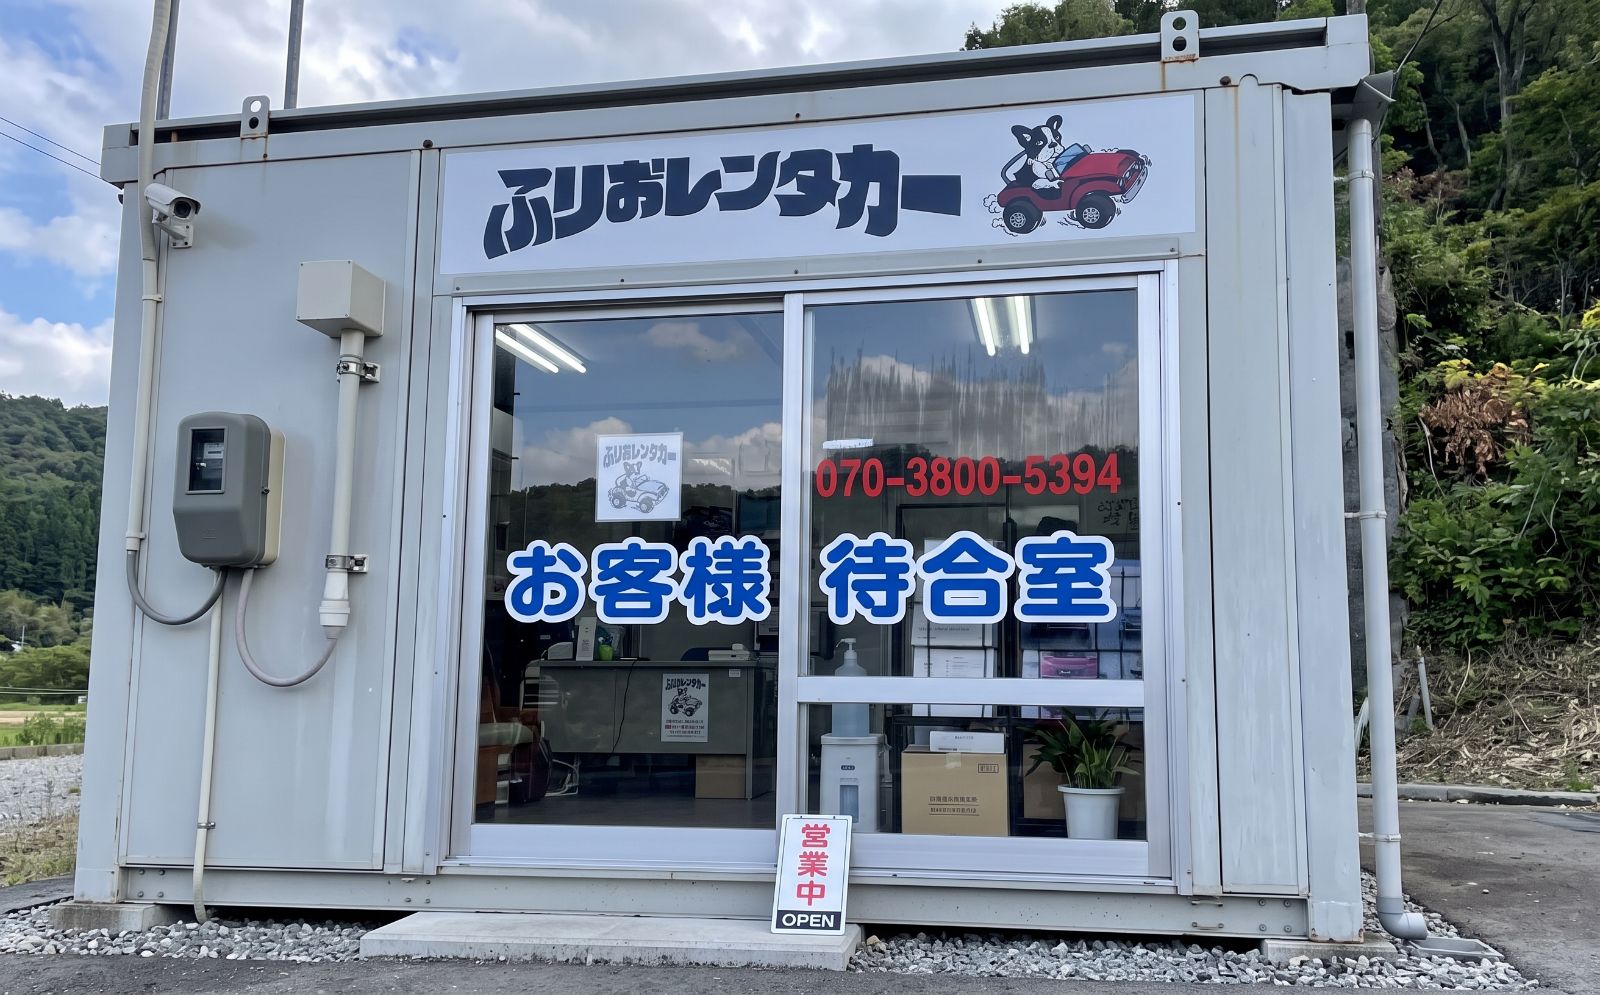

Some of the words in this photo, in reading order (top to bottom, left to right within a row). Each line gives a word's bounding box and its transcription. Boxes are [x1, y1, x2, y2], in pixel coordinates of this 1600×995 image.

[483, 143, 962, 260] ふりおレンタカー
[815, 452, 1121, 497] 070-3800-5394
[507, 537, 770, 623] お客様
[820, 532, 1115, 624] 待合室
[796, 823, 830, 907] 営業中
[781, 913, 835, 928] OPEN
